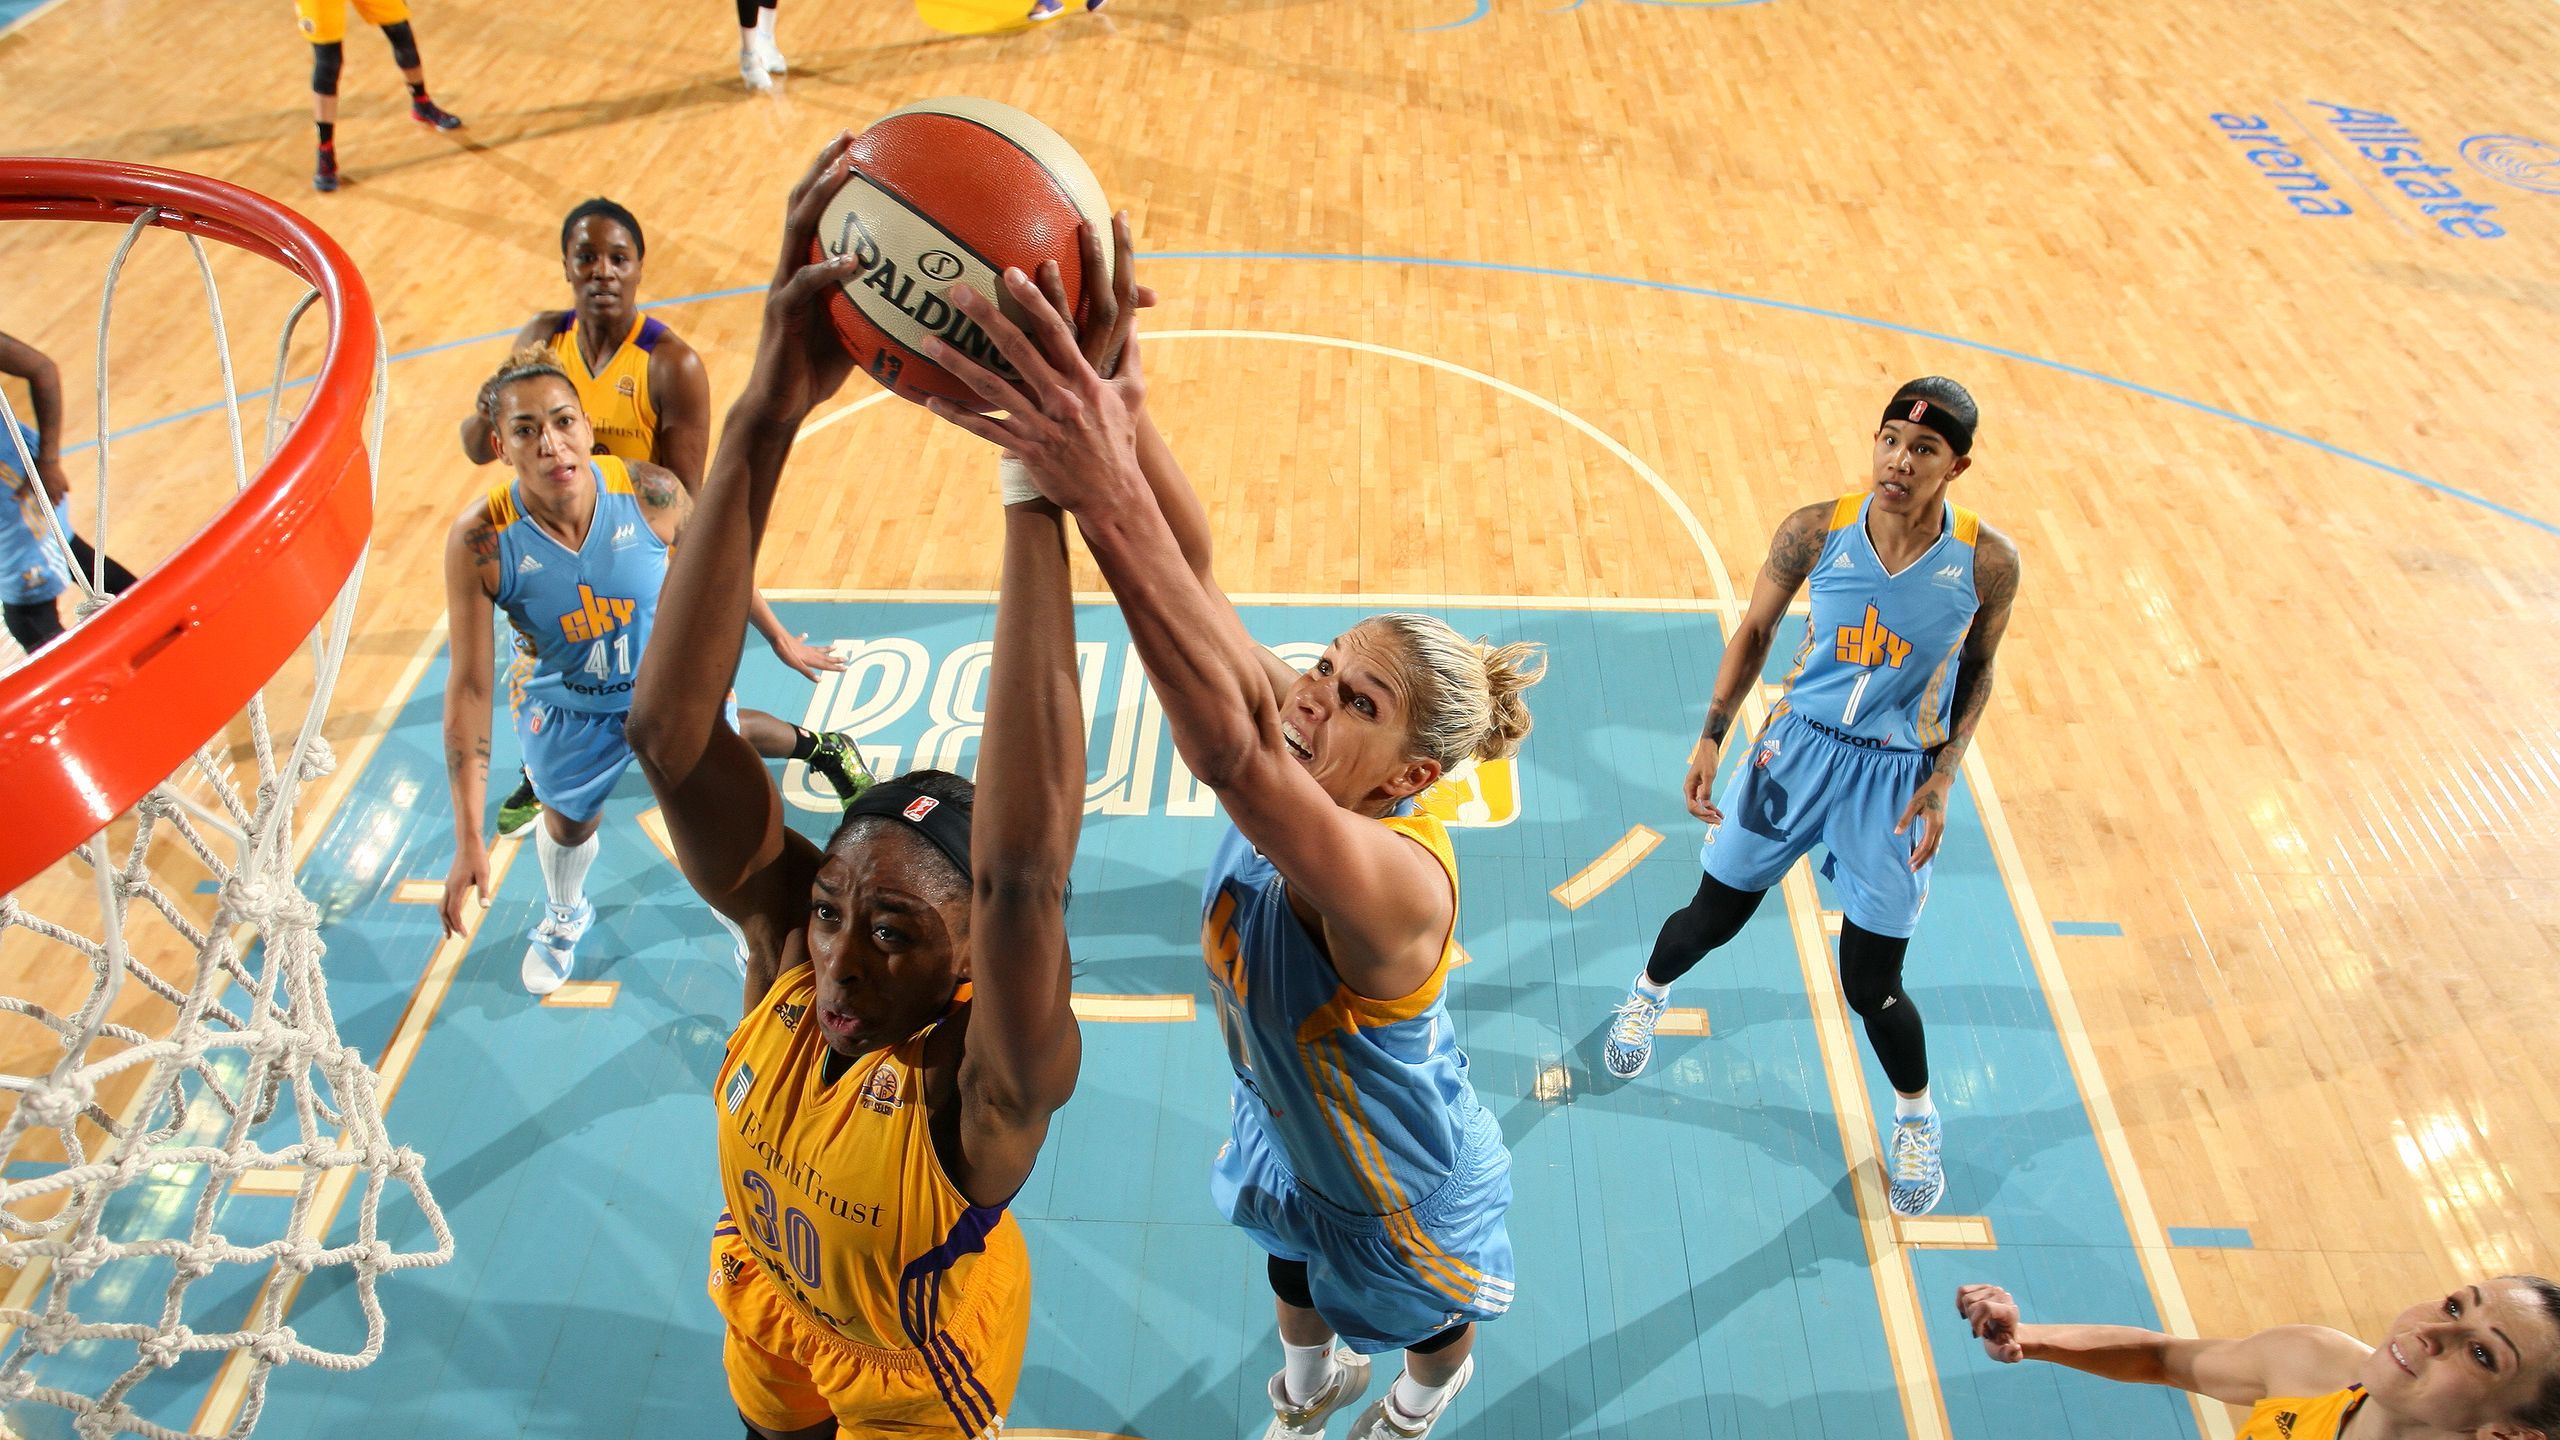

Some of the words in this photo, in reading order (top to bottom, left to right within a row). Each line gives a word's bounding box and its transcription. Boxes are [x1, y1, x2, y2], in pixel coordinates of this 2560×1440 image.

[2209, 112, 2354, 217] arena
[2307, 99, 2506, 239] Allstate
[584, 633, 631, 681] 41
[562, 679, 636, 697] verizo
[1842, 671, 1872, 726] 1
[1803, 714, 1881, 748] verizon
[774, 1005, 798, 1034] adida
[739, 1109, 887, 1228] EquiTrust
[743, 1169, 823, 1289] 30
